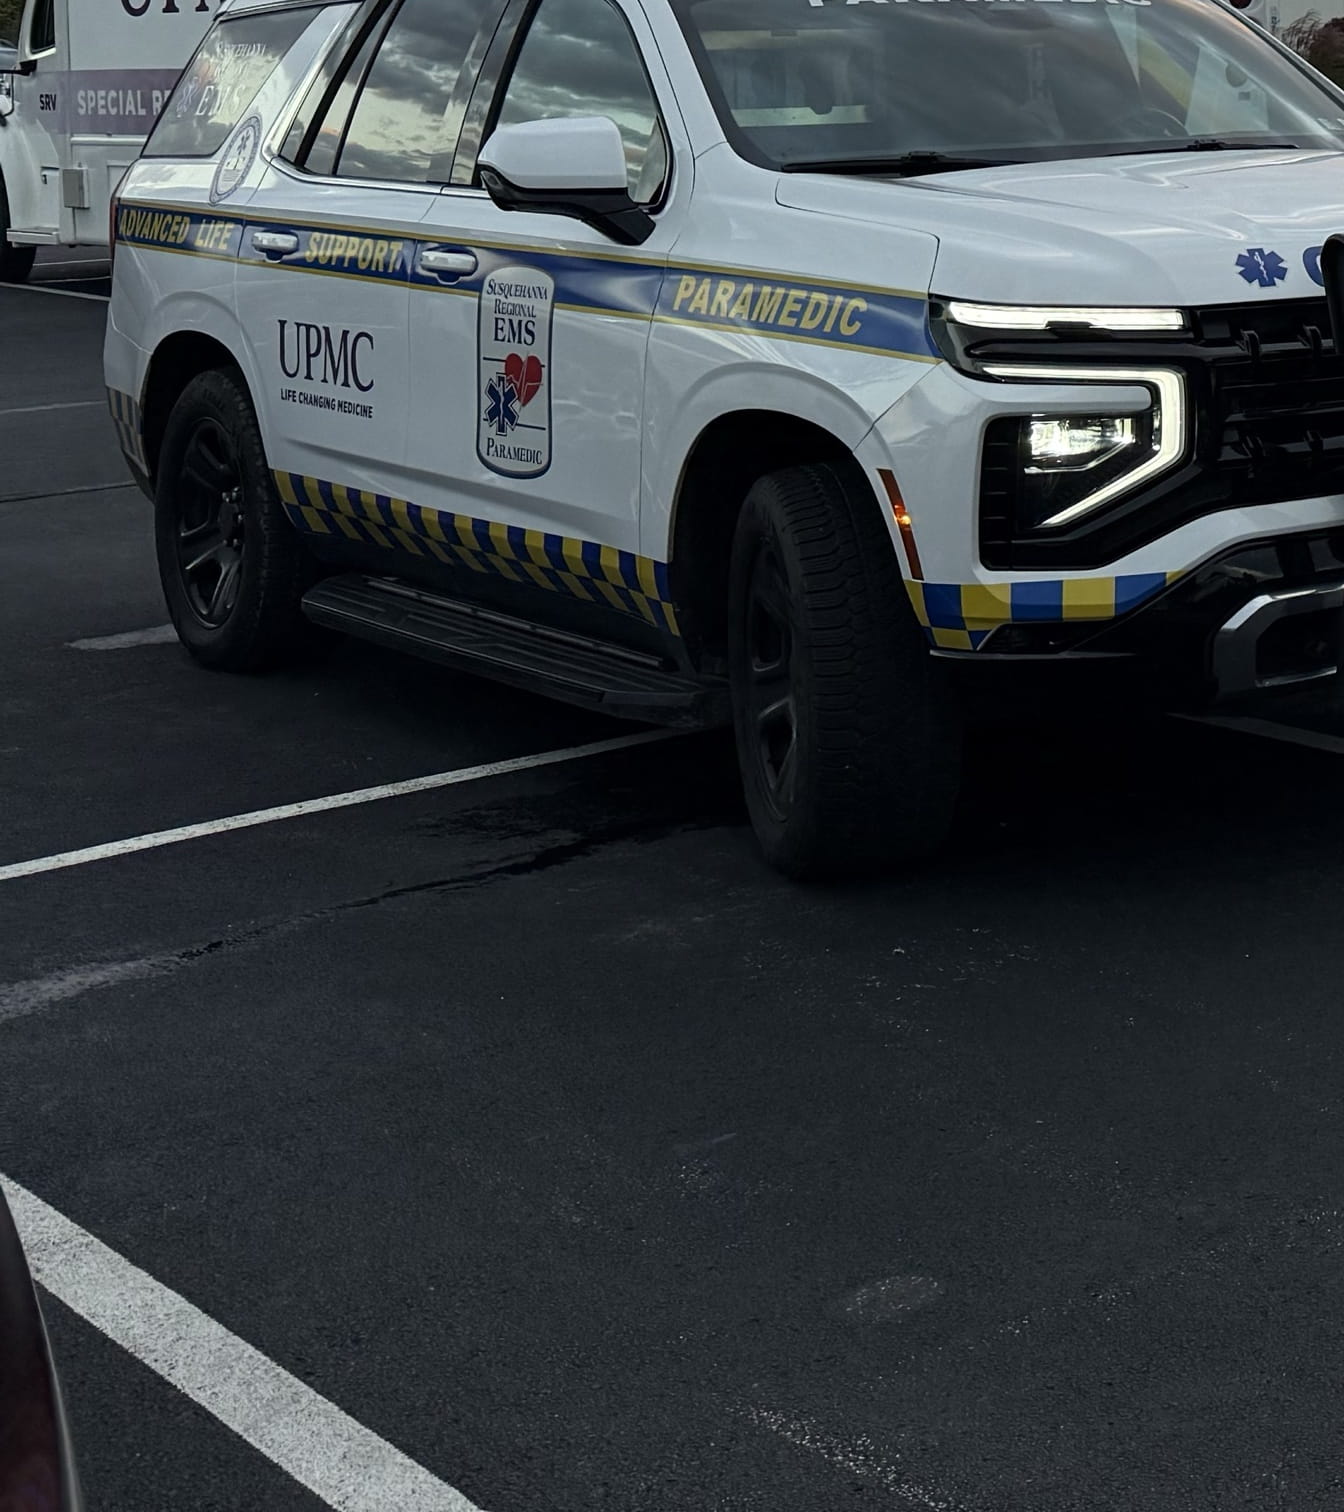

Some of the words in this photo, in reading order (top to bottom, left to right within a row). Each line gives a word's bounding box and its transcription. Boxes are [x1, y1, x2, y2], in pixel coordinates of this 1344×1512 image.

[39, 93, 57, 112] SRV
[77, 89, 147, 116] SPECIAL
[119, 209, 191, 245] ADVANCED
[194, 219, 236, 251] LIFE
[304, 231, 404, 274] SUPPORT
[486, 278, 548, 300] SUSQUEHANNA
[494, 298, 537, 318] REGIONAL
[672, 274, 868, 336] PARAMEDIC
[493, 317, 536, 346] EMS
[277, 319, 375, 393] UPMC
[280, 387, 297, 403] LIFE
[298, 391, 336, 411] CHANGING
[337, 399, 374, 419] MEDICINE
[486, 437, 543, 466] PARAMEDIC
